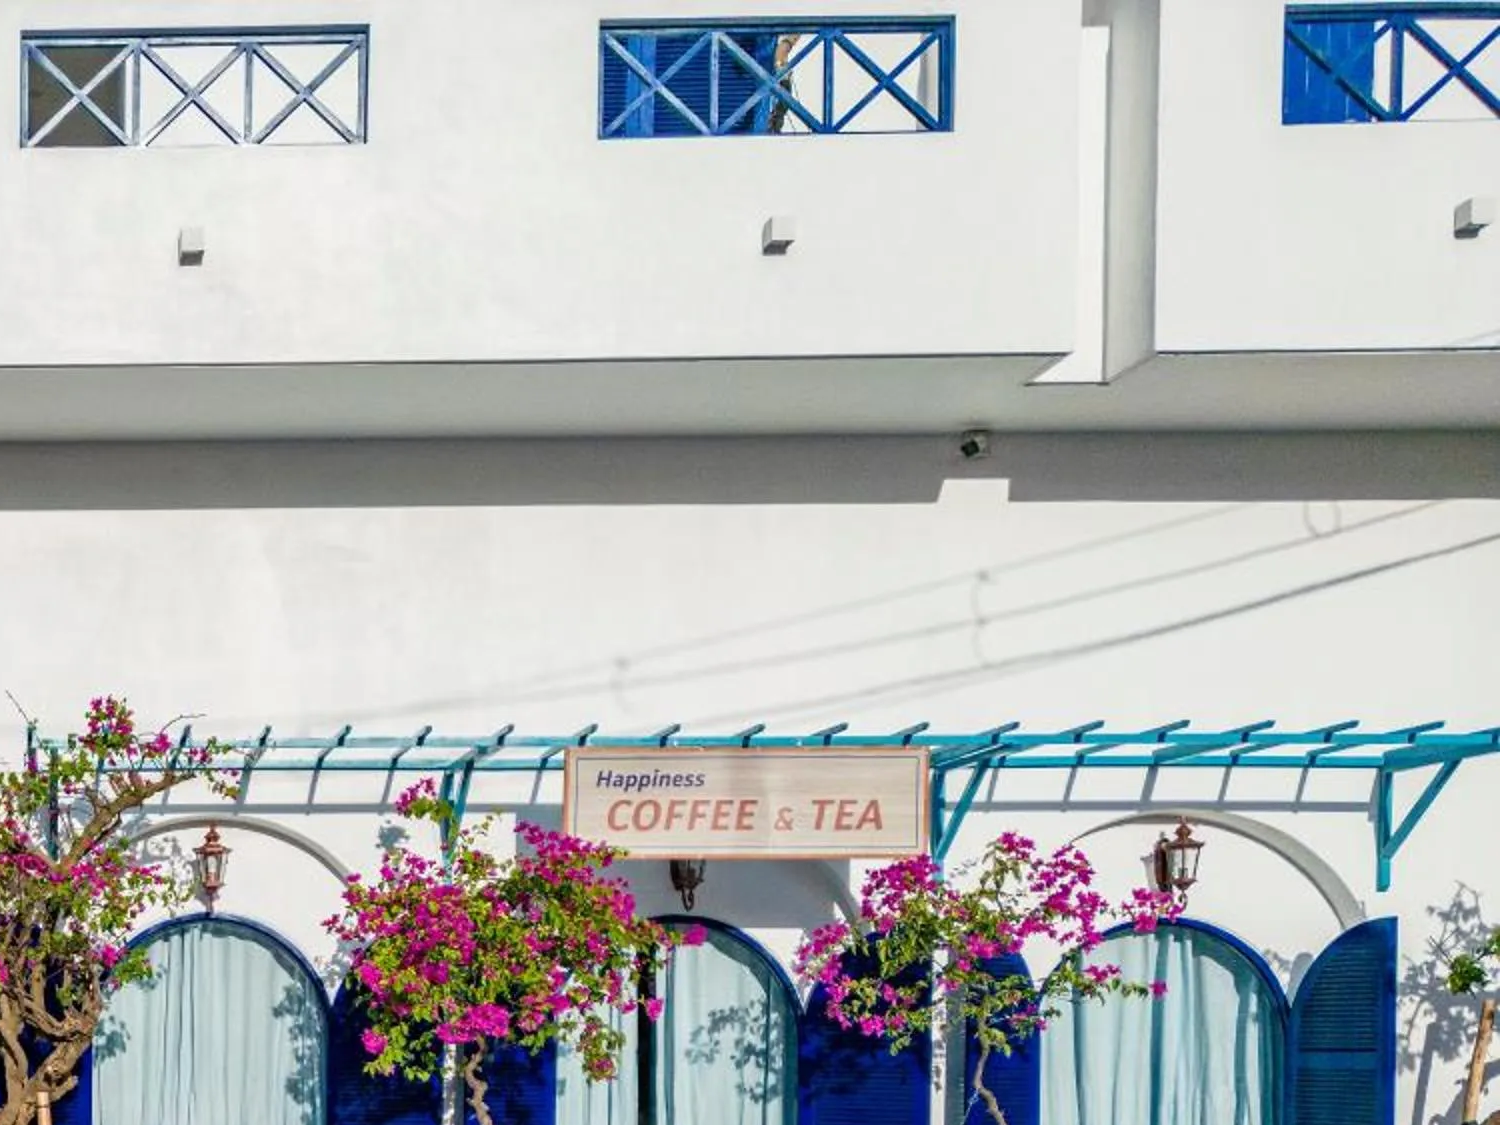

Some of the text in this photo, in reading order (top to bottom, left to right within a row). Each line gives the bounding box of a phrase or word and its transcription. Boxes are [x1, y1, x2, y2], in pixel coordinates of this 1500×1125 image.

[596, 769, 705, 792] Happiness
[606, 799, 883, 832] COFFEE & TEA
